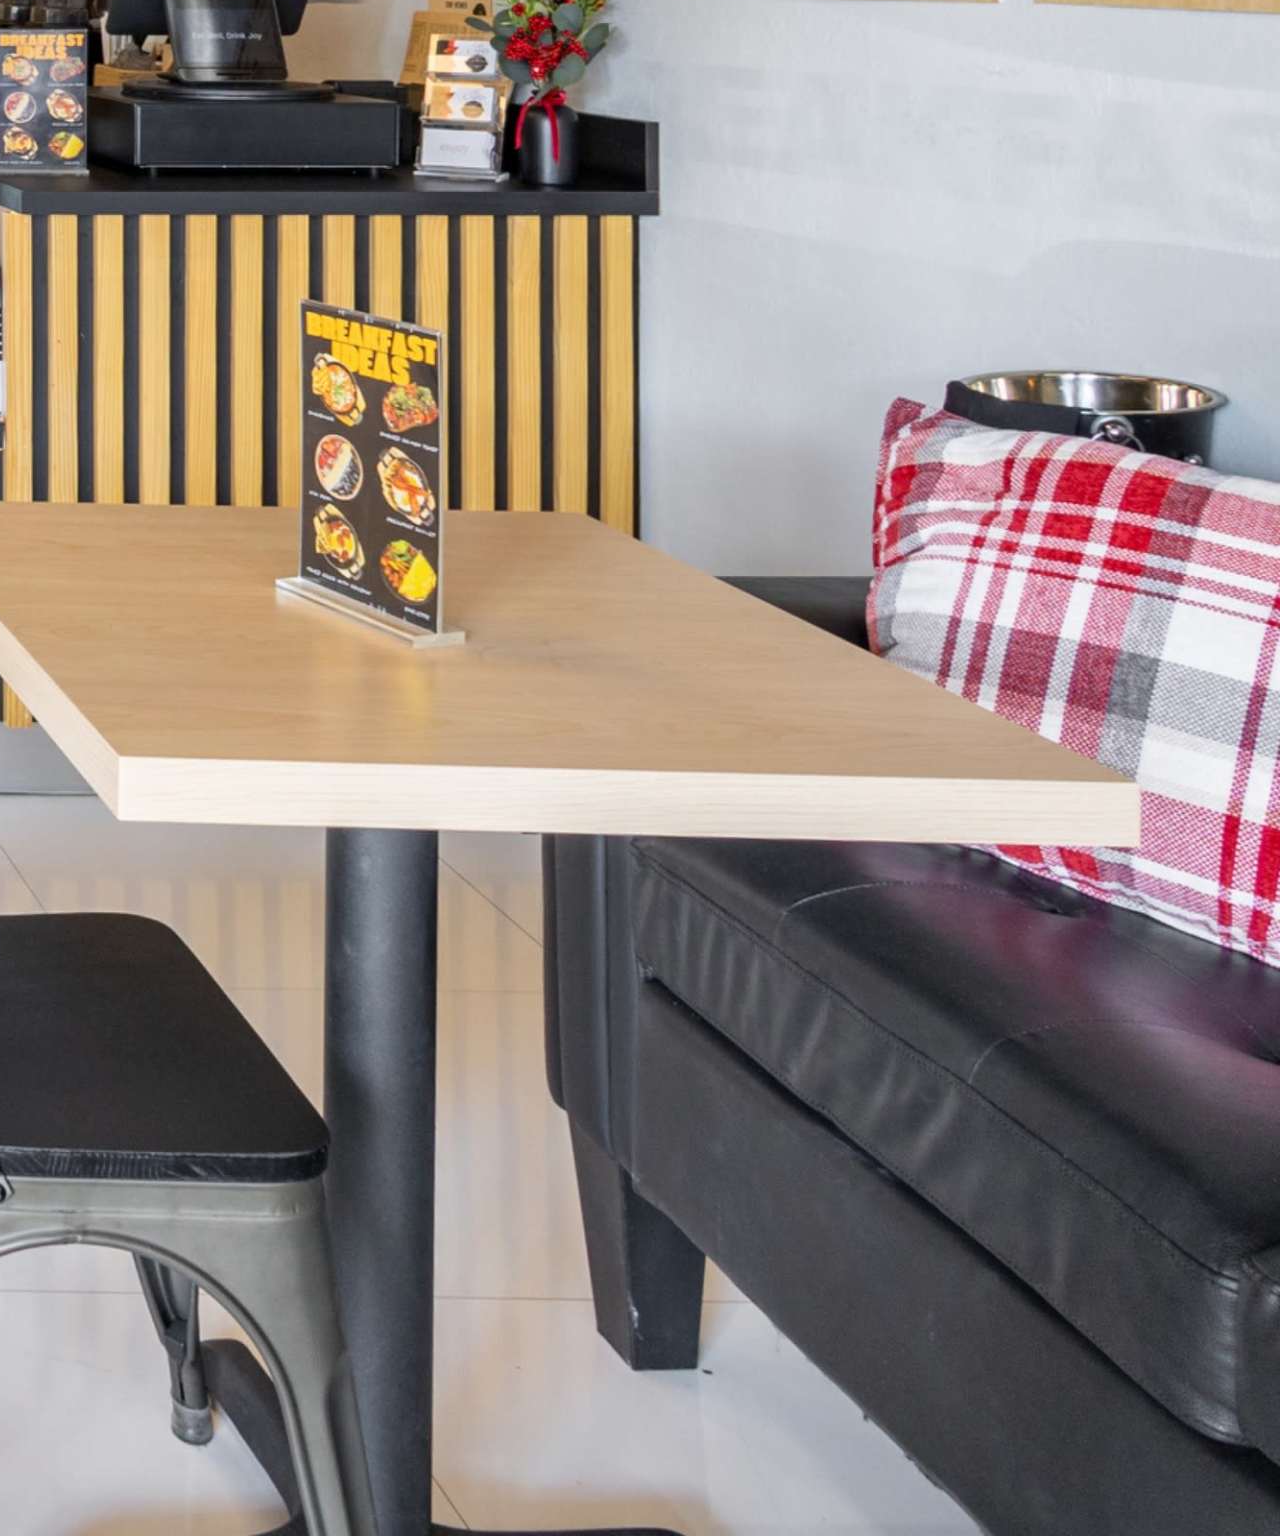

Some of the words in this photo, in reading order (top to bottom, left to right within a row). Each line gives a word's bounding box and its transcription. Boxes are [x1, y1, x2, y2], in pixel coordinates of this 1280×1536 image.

[0, 34, 84, 46] BREAKFAST
[306, 311, 437, 365] BREAKFAST
[331, 340, 411, 386] IDEAS
